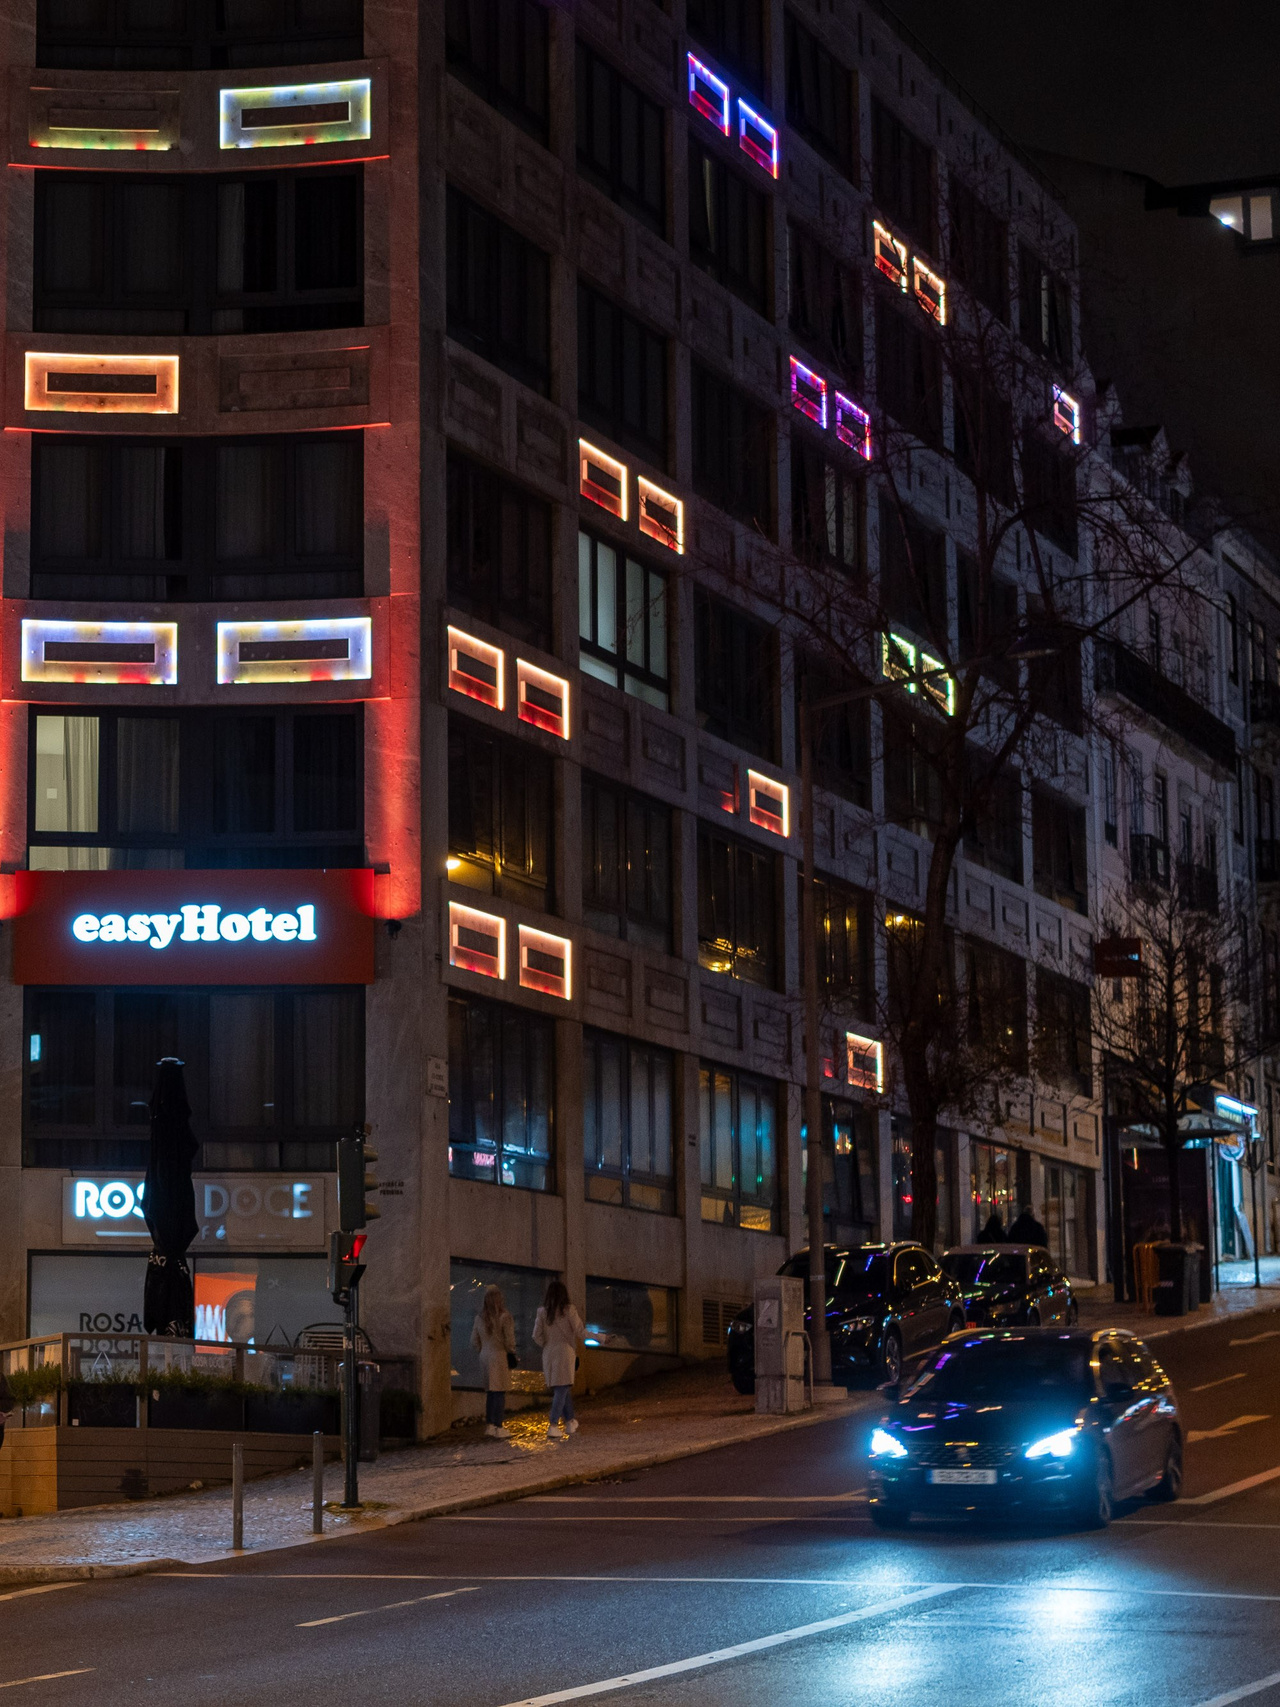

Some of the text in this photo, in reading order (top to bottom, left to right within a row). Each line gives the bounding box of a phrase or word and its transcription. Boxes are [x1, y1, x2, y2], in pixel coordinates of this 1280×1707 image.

[72, 904, 318, 949] easyHotel
[75, 1181, 313, 1218] RO DOCE
[80, 1312, 142, 1332] ROSA
